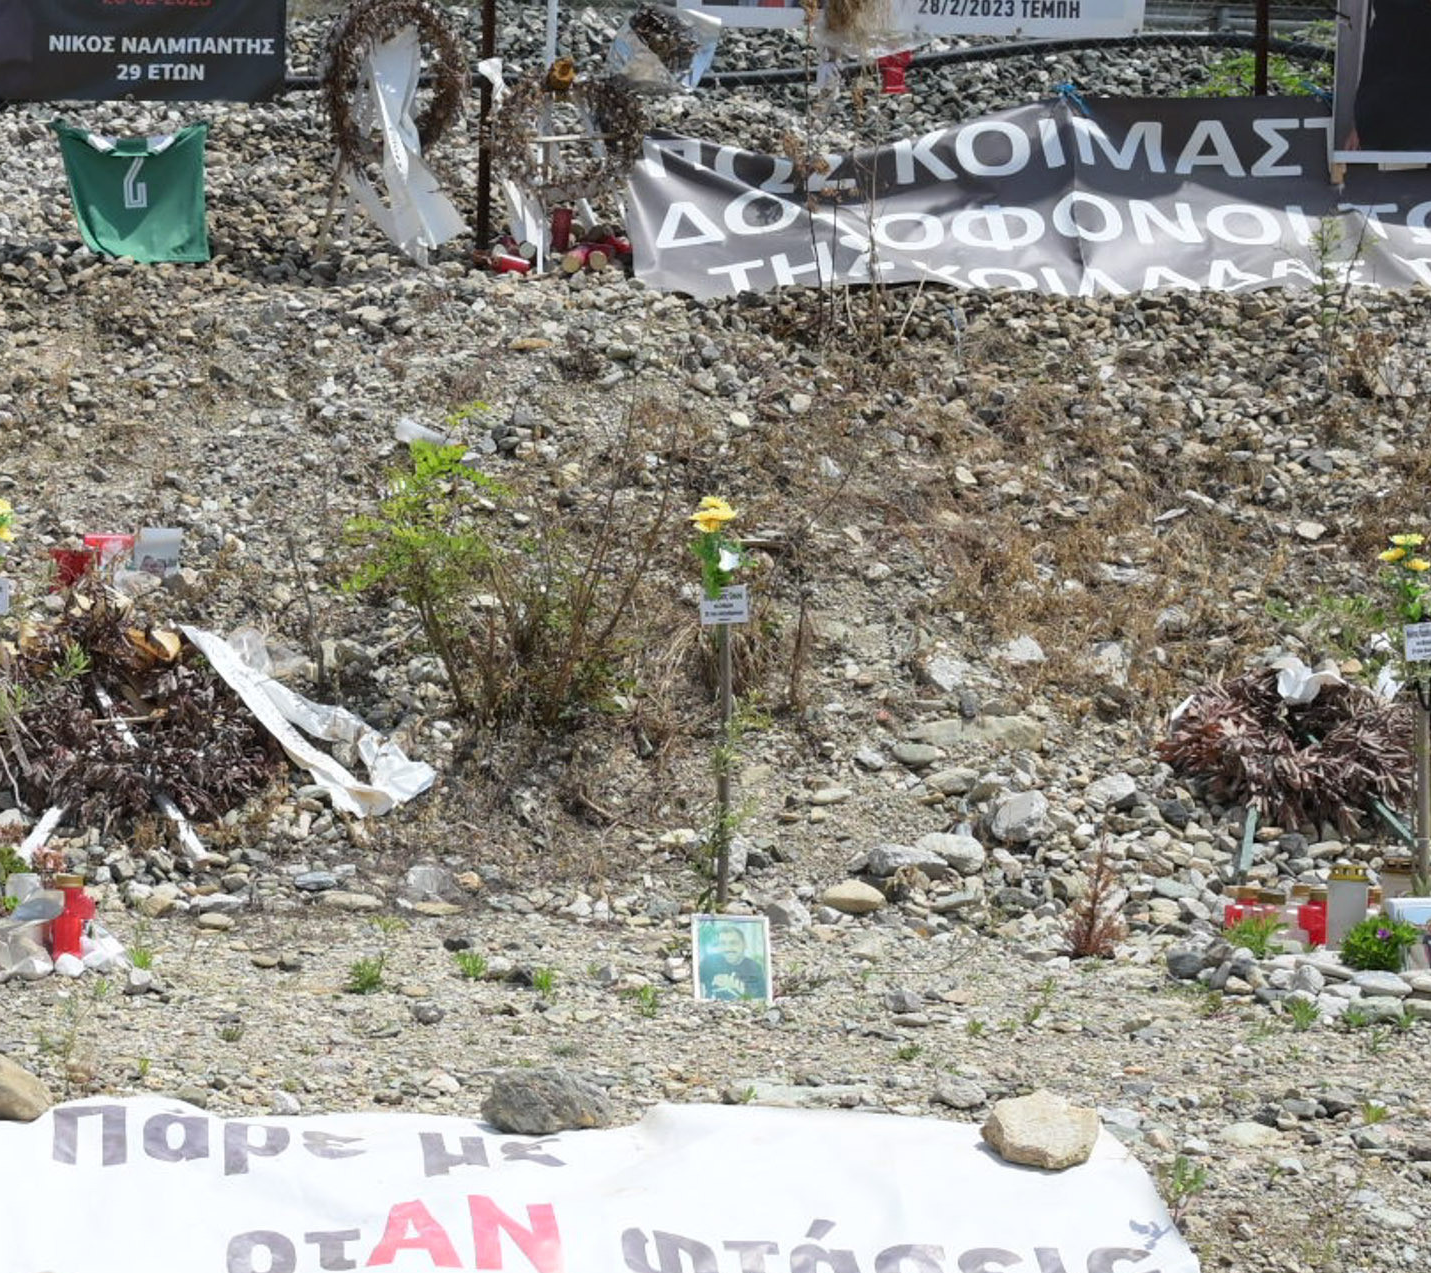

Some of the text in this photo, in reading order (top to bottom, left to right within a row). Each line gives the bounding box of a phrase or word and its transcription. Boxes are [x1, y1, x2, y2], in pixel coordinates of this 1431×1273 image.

[1020, 0, 1081, 19] ΤΕΜΠΗ
[48, 34, 276, 57] ΝΙΚΟΣ ΝΑΛΜΠΑΝΤΗΣ
[116, 63, 206, 82] 29 ΕΤΩΝ
[894, 118, 1333, 185] ΚΟΙΜΑΣΤ
[50, 1102, 366, 1178] Πάρε
